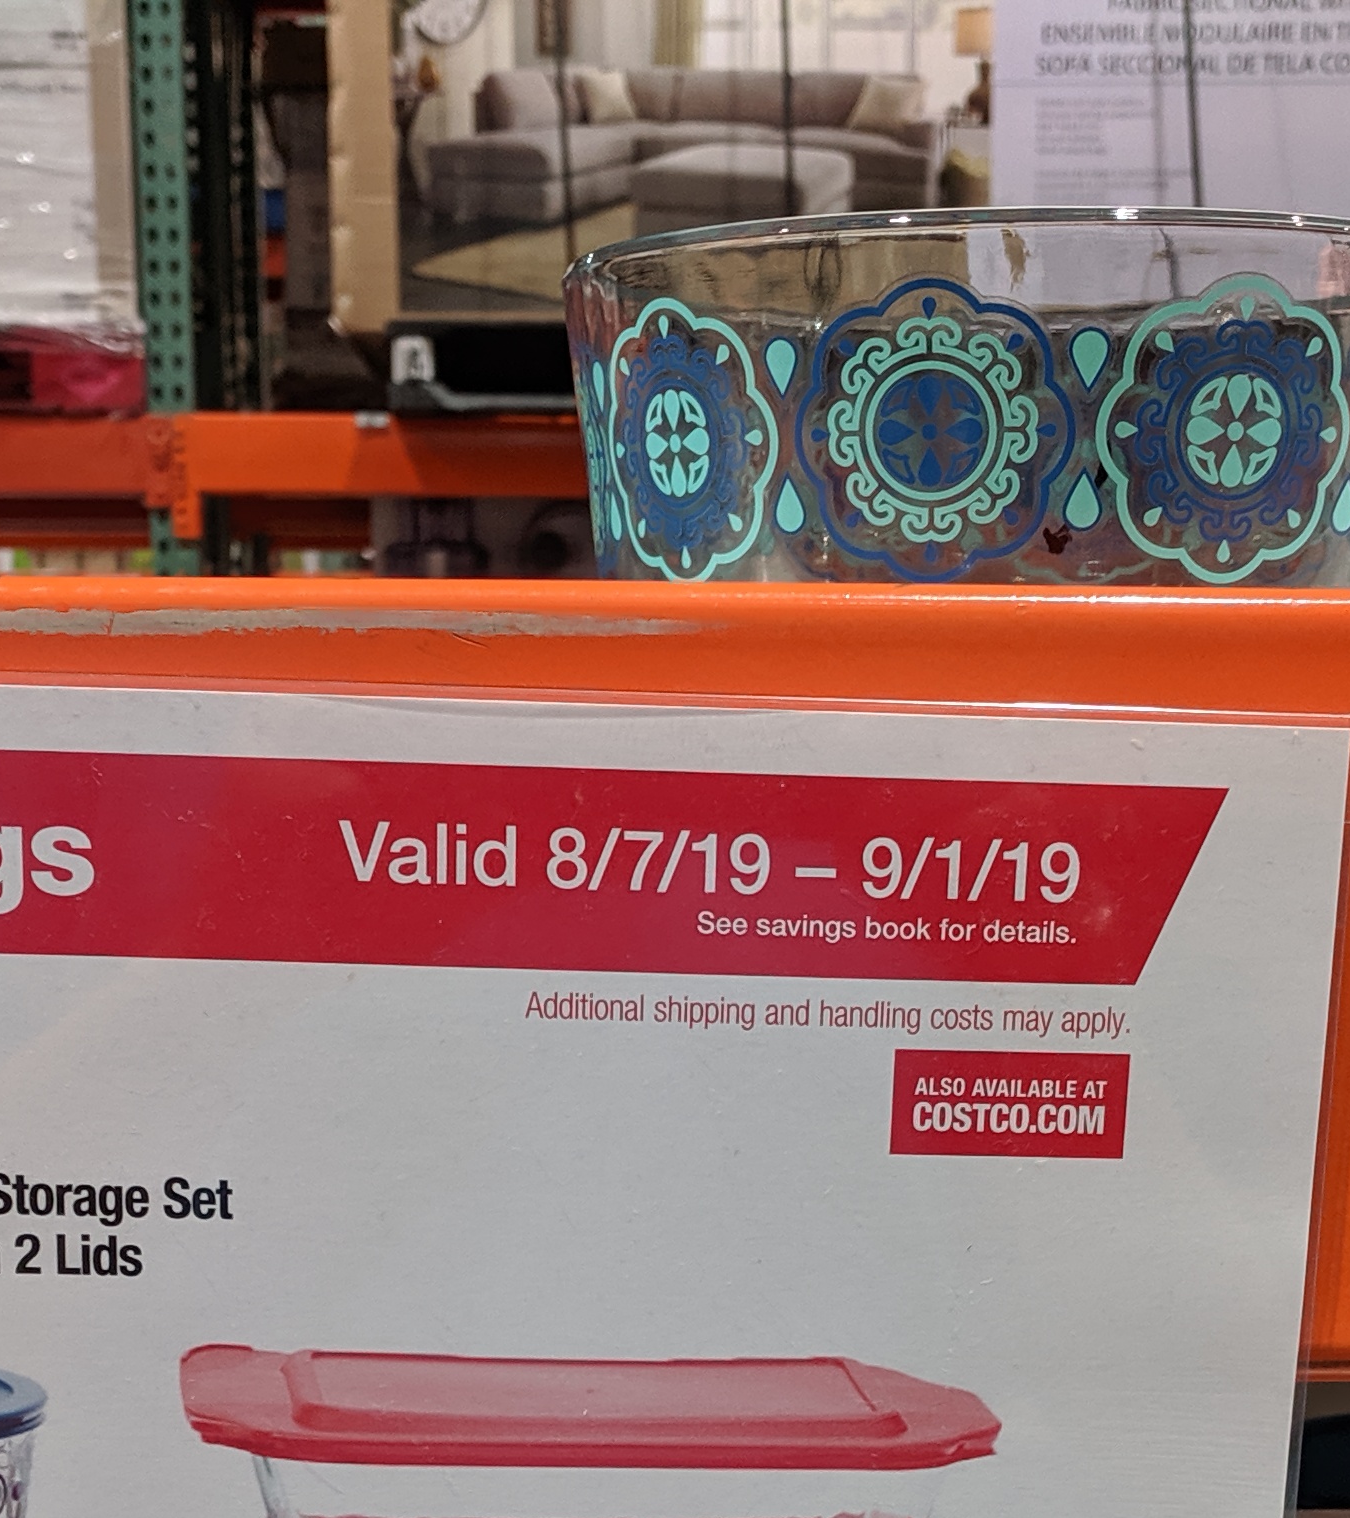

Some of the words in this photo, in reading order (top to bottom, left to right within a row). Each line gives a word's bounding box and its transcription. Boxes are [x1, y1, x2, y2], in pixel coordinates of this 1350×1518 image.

[338, 819, 518, 888] Valid
[546, 826, 772, 896] 8/7/19
[861, 836, 1082, 904] 9/1/19
[696, 909, 749, 939] See
[755, 912, 857, 946] savings
[864, 914, 932, 942] book
[938, 917, 977, 943] for
[982, 918, 1078, 945] details.
[524, 990, 645, 1023] Additional
[652, 994, 755, 1031] shipping
[763, 997, 811, 1027] and
[818, 998, 922, 1035] handling
[930, 1005, 994, 1032] costs
[1001, 1010, 1054, 1038] may
[1060, 1005, 1132, 1040] apply.
[913, 1076, 966, 1098] ALSO
[970, 1077, 1078, 1100] AVAILABLE
[1083, 1080, 1108, 1100] AT
[911, 1101, 1107, 1136] COSTCO.COM
[162, 1178, 234, 1222] Set
[13, 1234, 42, 1276] 2
[54, 1234, 144, 1279] Lids
